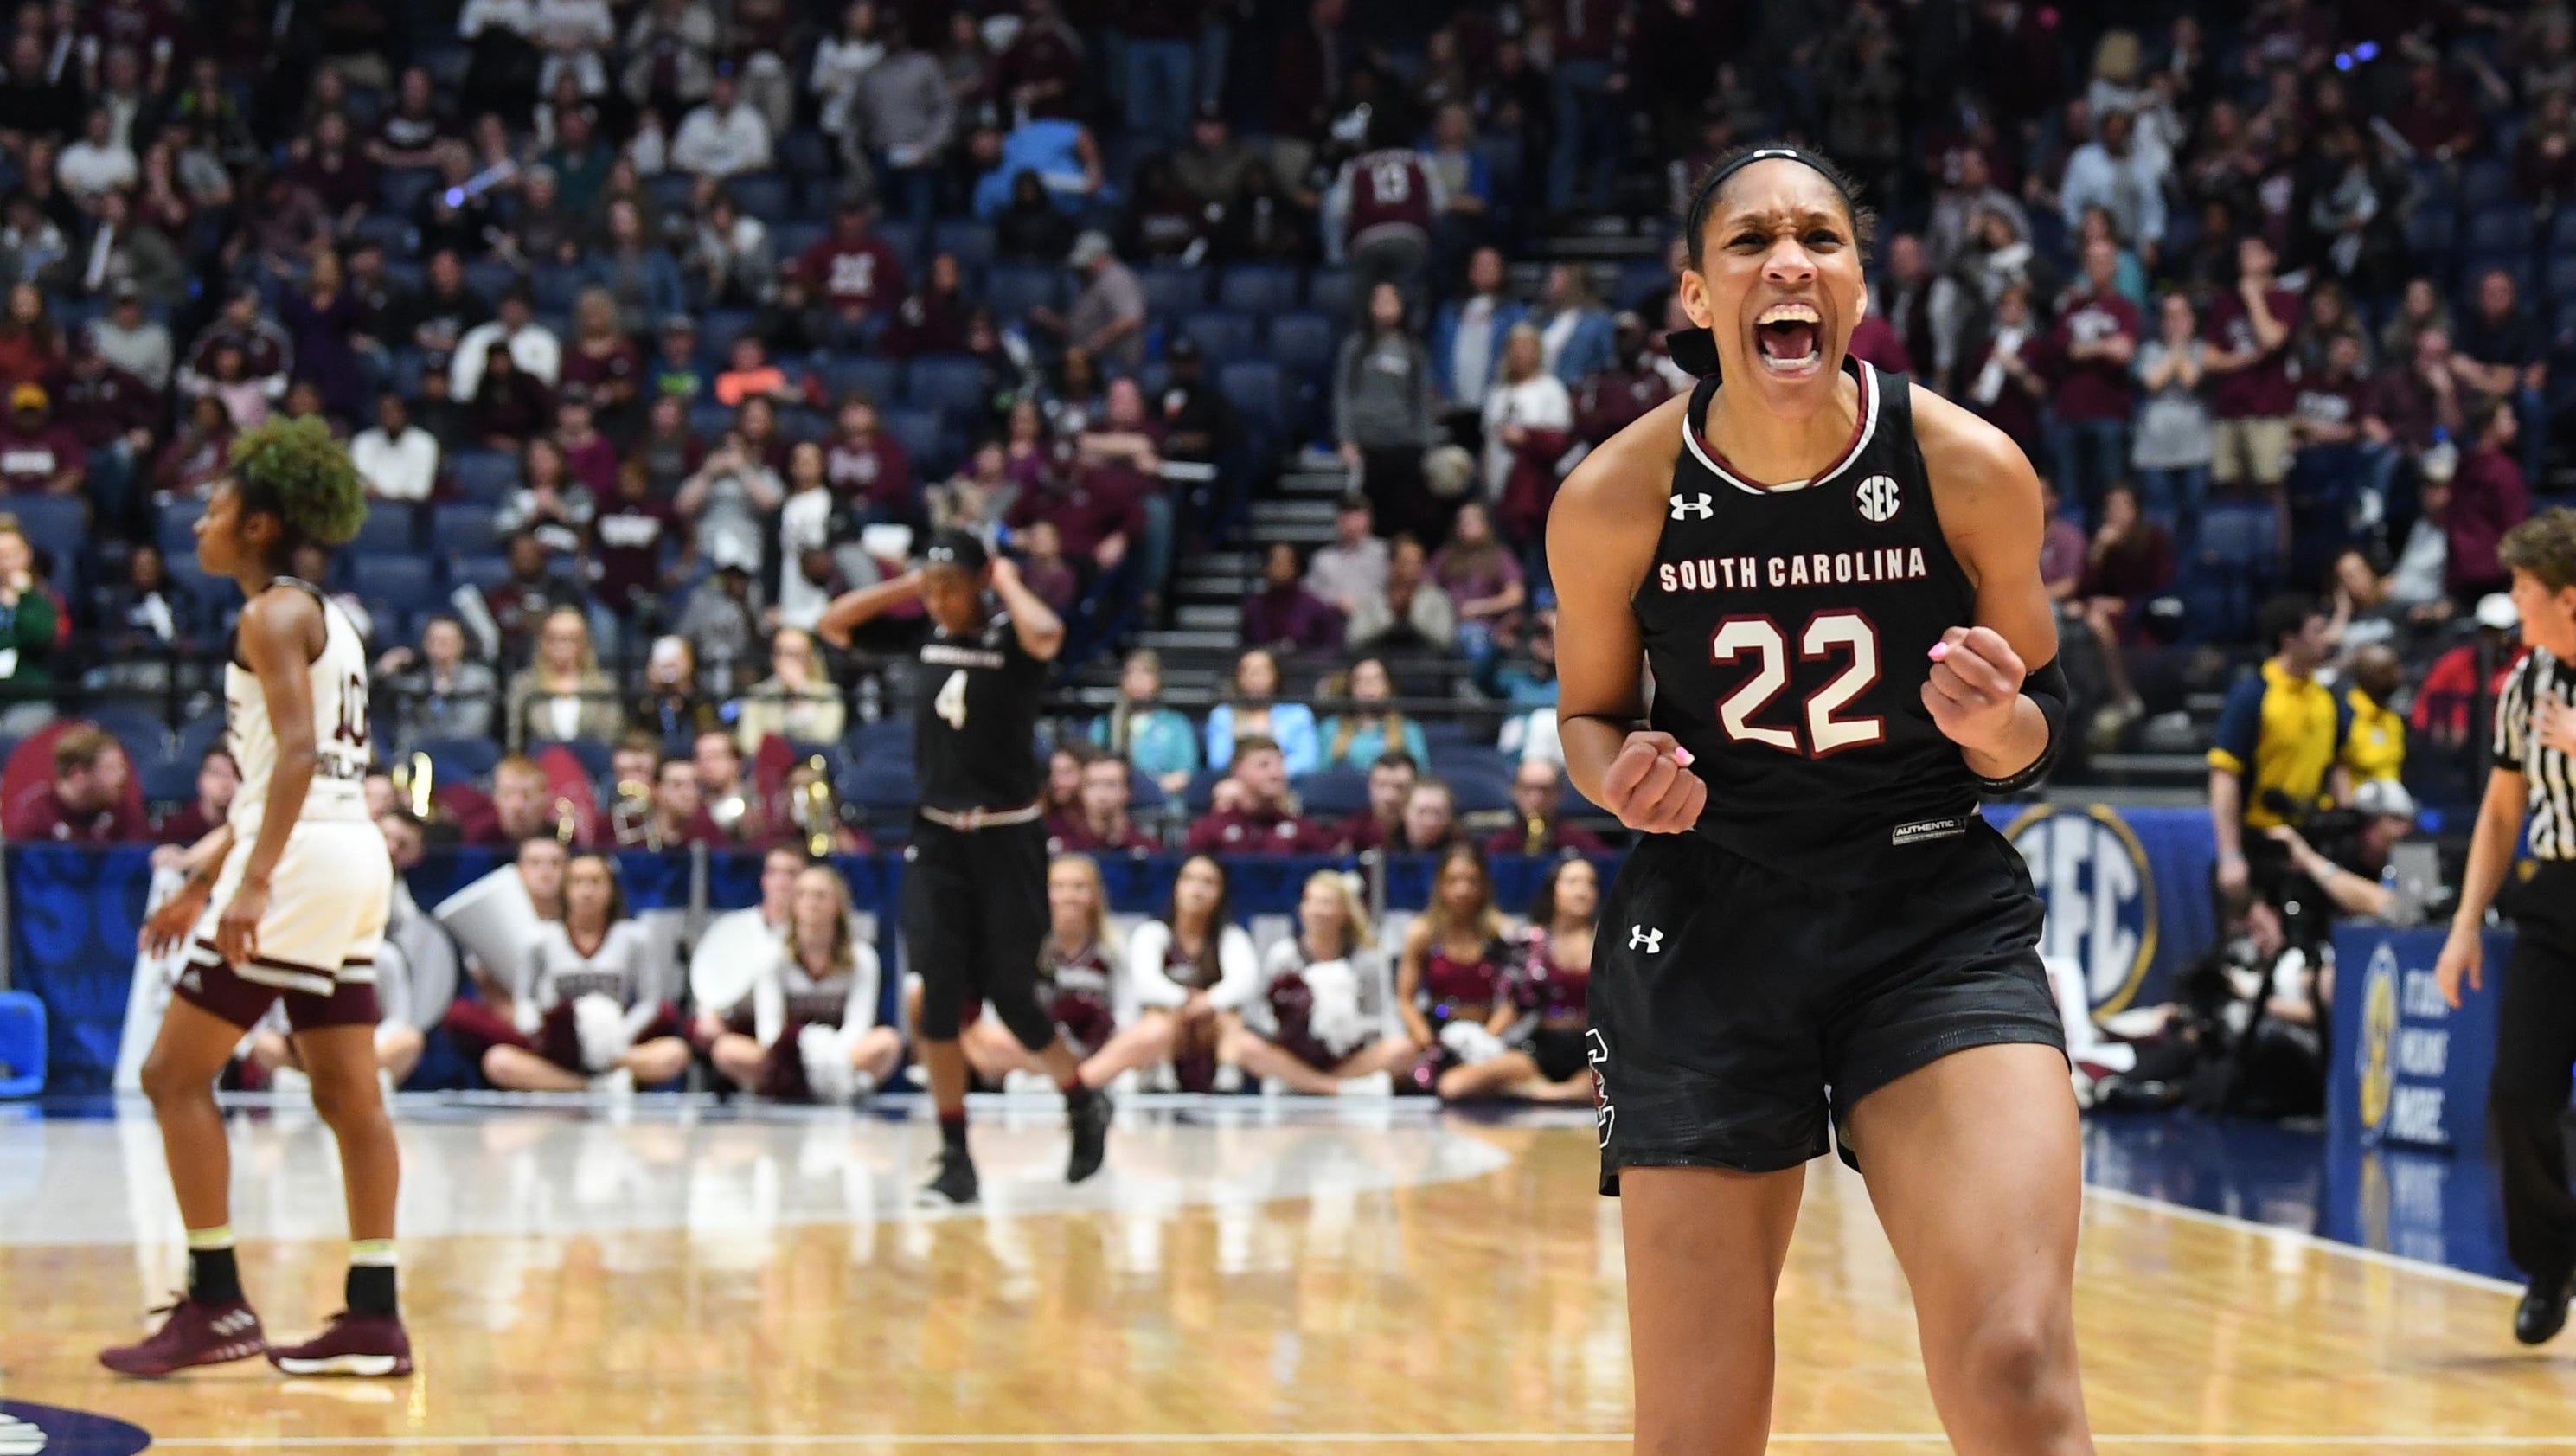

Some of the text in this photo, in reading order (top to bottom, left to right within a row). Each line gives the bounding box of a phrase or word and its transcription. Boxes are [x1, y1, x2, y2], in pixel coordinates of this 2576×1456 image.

[1855, 474, 1900, 522] SEC
[1659, 547, 1927, 592] SOUTH CAROLINA
[934, 668, 968, 730] 4
[1710, 609, 1884, 758] 22
[1895, 819, 1955, 837] AUTHENTIC
